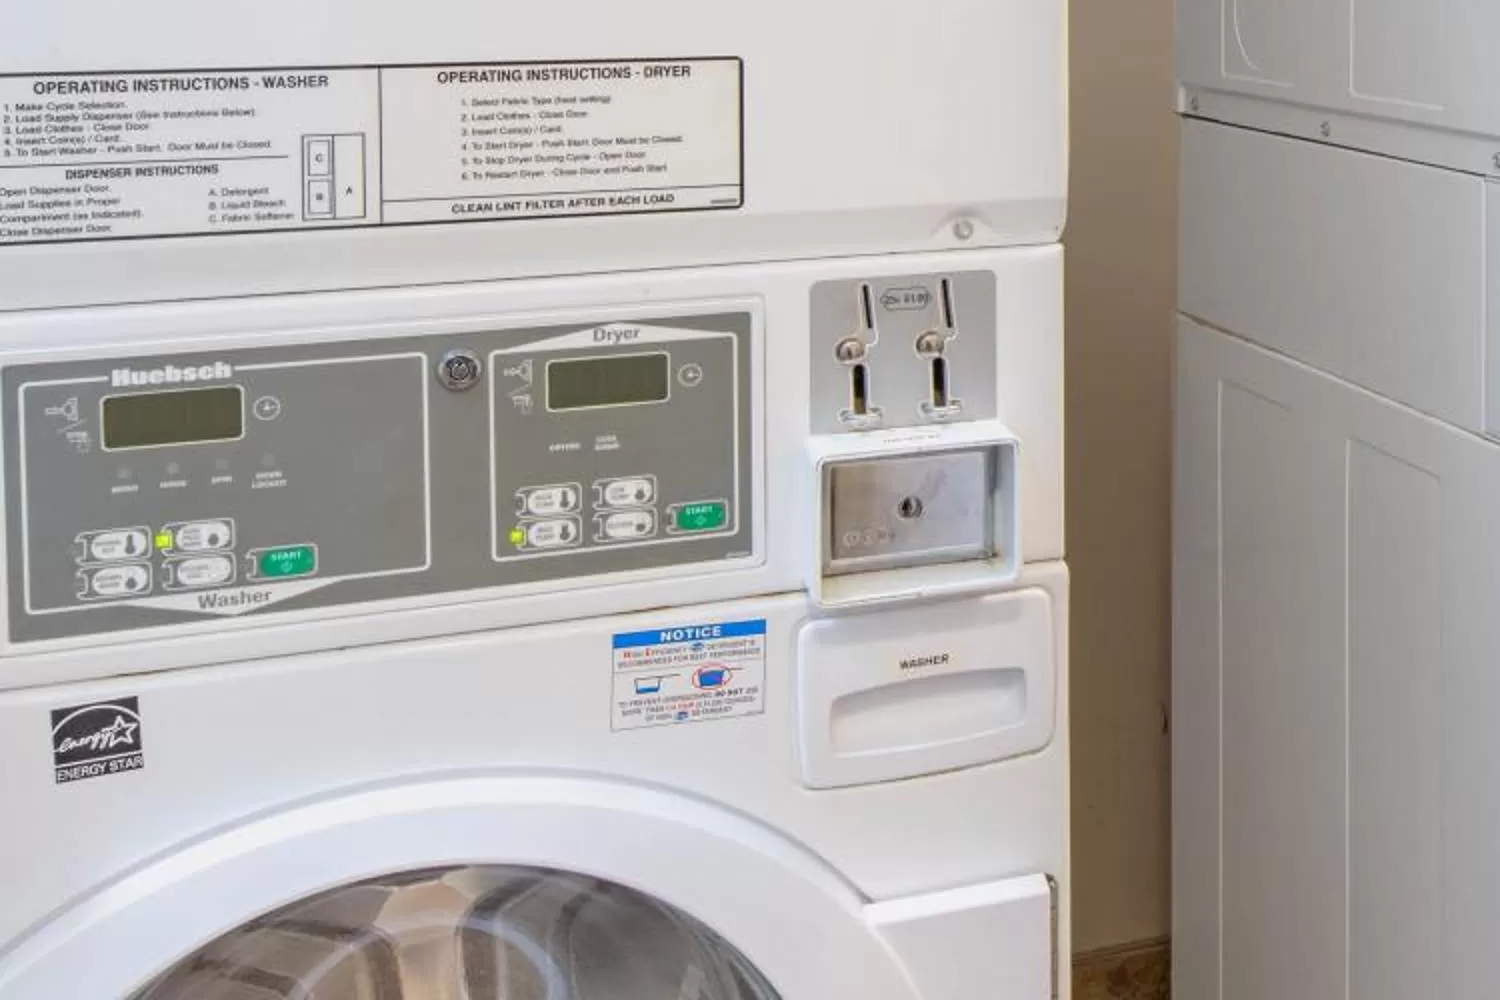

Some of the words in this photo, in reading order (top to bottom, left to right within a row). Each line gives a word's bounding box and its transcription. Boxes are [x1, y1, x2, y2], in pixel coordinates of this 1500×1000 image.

[437, 69, 522, 83] OPERATING
[526, 67, 631, 81] INSTRUCTIONS
[643, 65, 692, 78] DRYER
[33, 79, 128, 95] OPERATING
[133, 76, 249, 92] INSTRUCTIONS
[262, 75, 329, 89] WASHER
[15, 115, 42, 123] Load
[65, 167, 132, 180] DISPENSER
[136, 164, 219, 178] INSTRUCTIONS
[451, 202, 493, 214] CLEAN
[495, 201, 521, 212] LINT
[526, 199, 565, 210] FILTER
[568, 197, 605, 208] AFTER
[608, 195, 641, 206] EACH
[643, 193, 675, 205] LOAD
[592, 327, 641, 345] Dryer
[111, 361, 233, 387] Huebsch
[685, 506, 713, 516] START
[271, 550, 301, 561] START
[198, 590, 272, 609] Washer
[660, 625, 722, 642] NOTICE
[900, 653, 949, 669] WASHER
[57, 762, 106, 781] ENERGY
[109, 756, 143, 772] STAR
